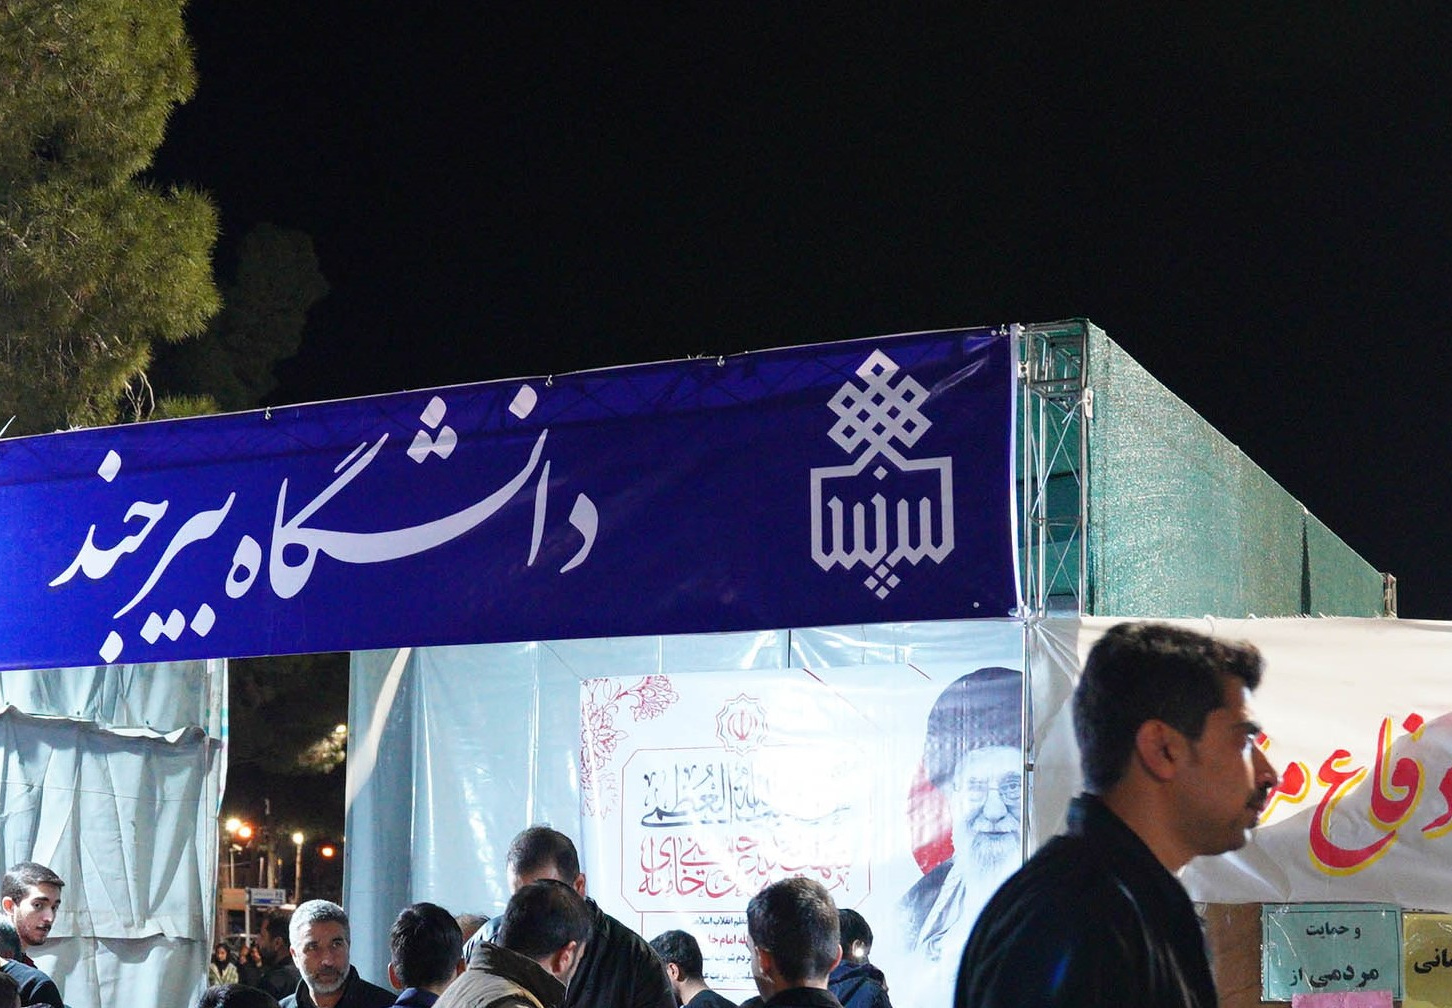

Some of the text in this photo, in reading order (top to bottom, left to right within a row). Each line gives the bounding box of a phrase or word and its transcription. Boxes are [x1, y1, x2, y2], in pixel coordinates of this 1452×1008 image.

[225, 384, 599, 600] دانشگاه
[49, 449, 236, 664] بیرجند
[1290, 964, 1380, 988] مردمی از
[1305, 921, 1362, 940] و حمایت
